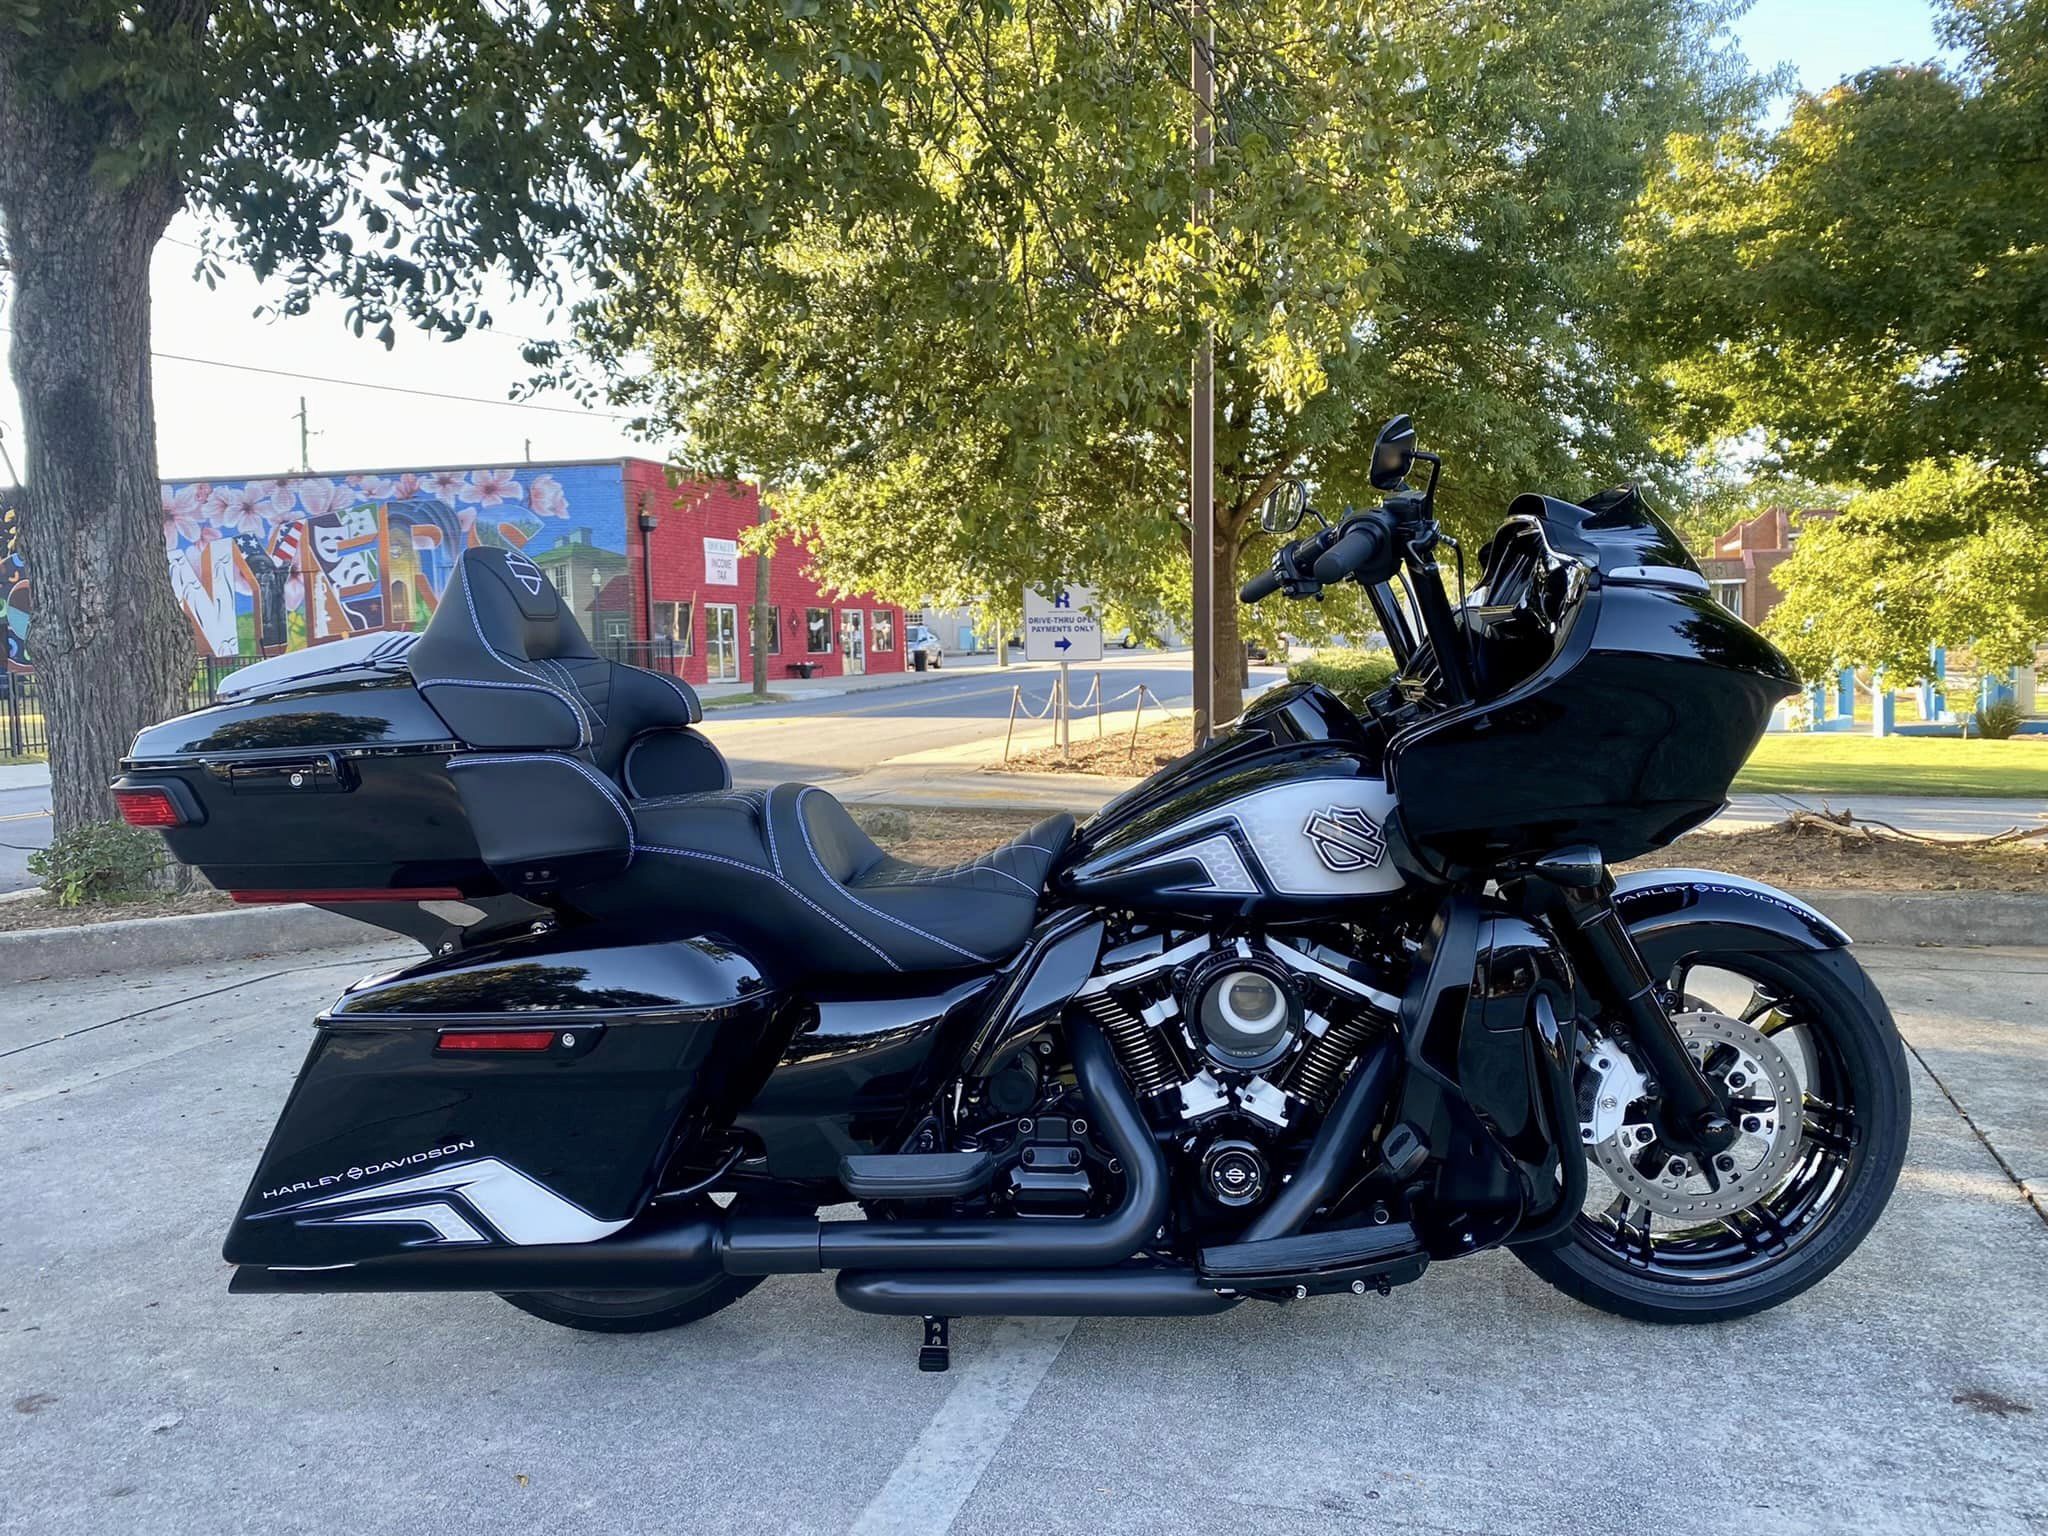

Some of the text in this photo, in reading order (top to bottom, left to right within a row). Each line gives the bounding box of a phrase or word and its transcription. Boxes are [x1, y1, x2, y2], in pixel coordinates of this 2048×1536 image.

[1028, 616, 1075, 625] DRIVE-THRU
[1031, 625, 1094, 633] PAYMENTS ONLY
[1711, 885, 1817, 922] DAVIDSON
[263, 1140, 475, 1200] HARLEY DAVIDSON
